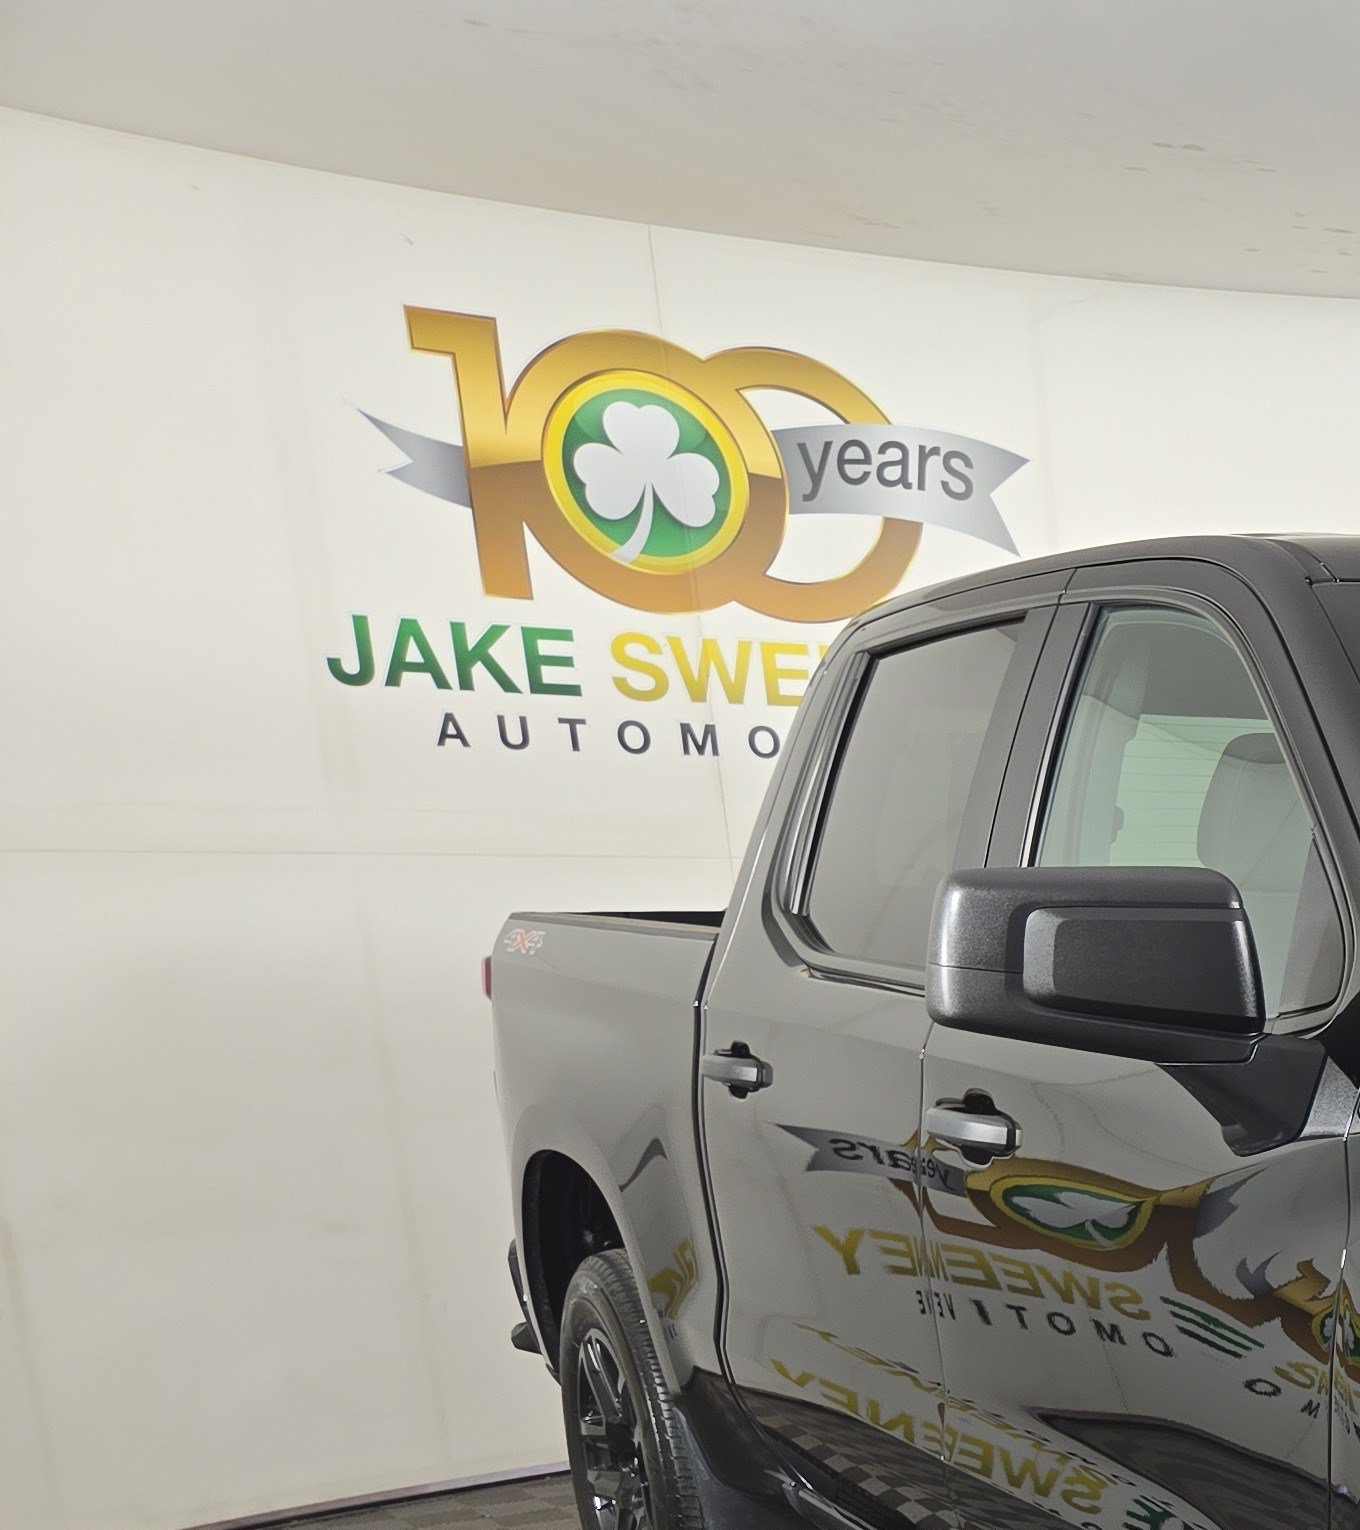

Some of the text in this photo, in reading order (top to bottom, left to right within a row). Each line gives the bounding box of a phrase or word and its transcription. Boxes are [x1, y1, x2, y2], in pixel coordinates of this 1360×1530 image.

[797, 438, 977, 502] years
[326, 614, 836, 708] JAKE SWE
